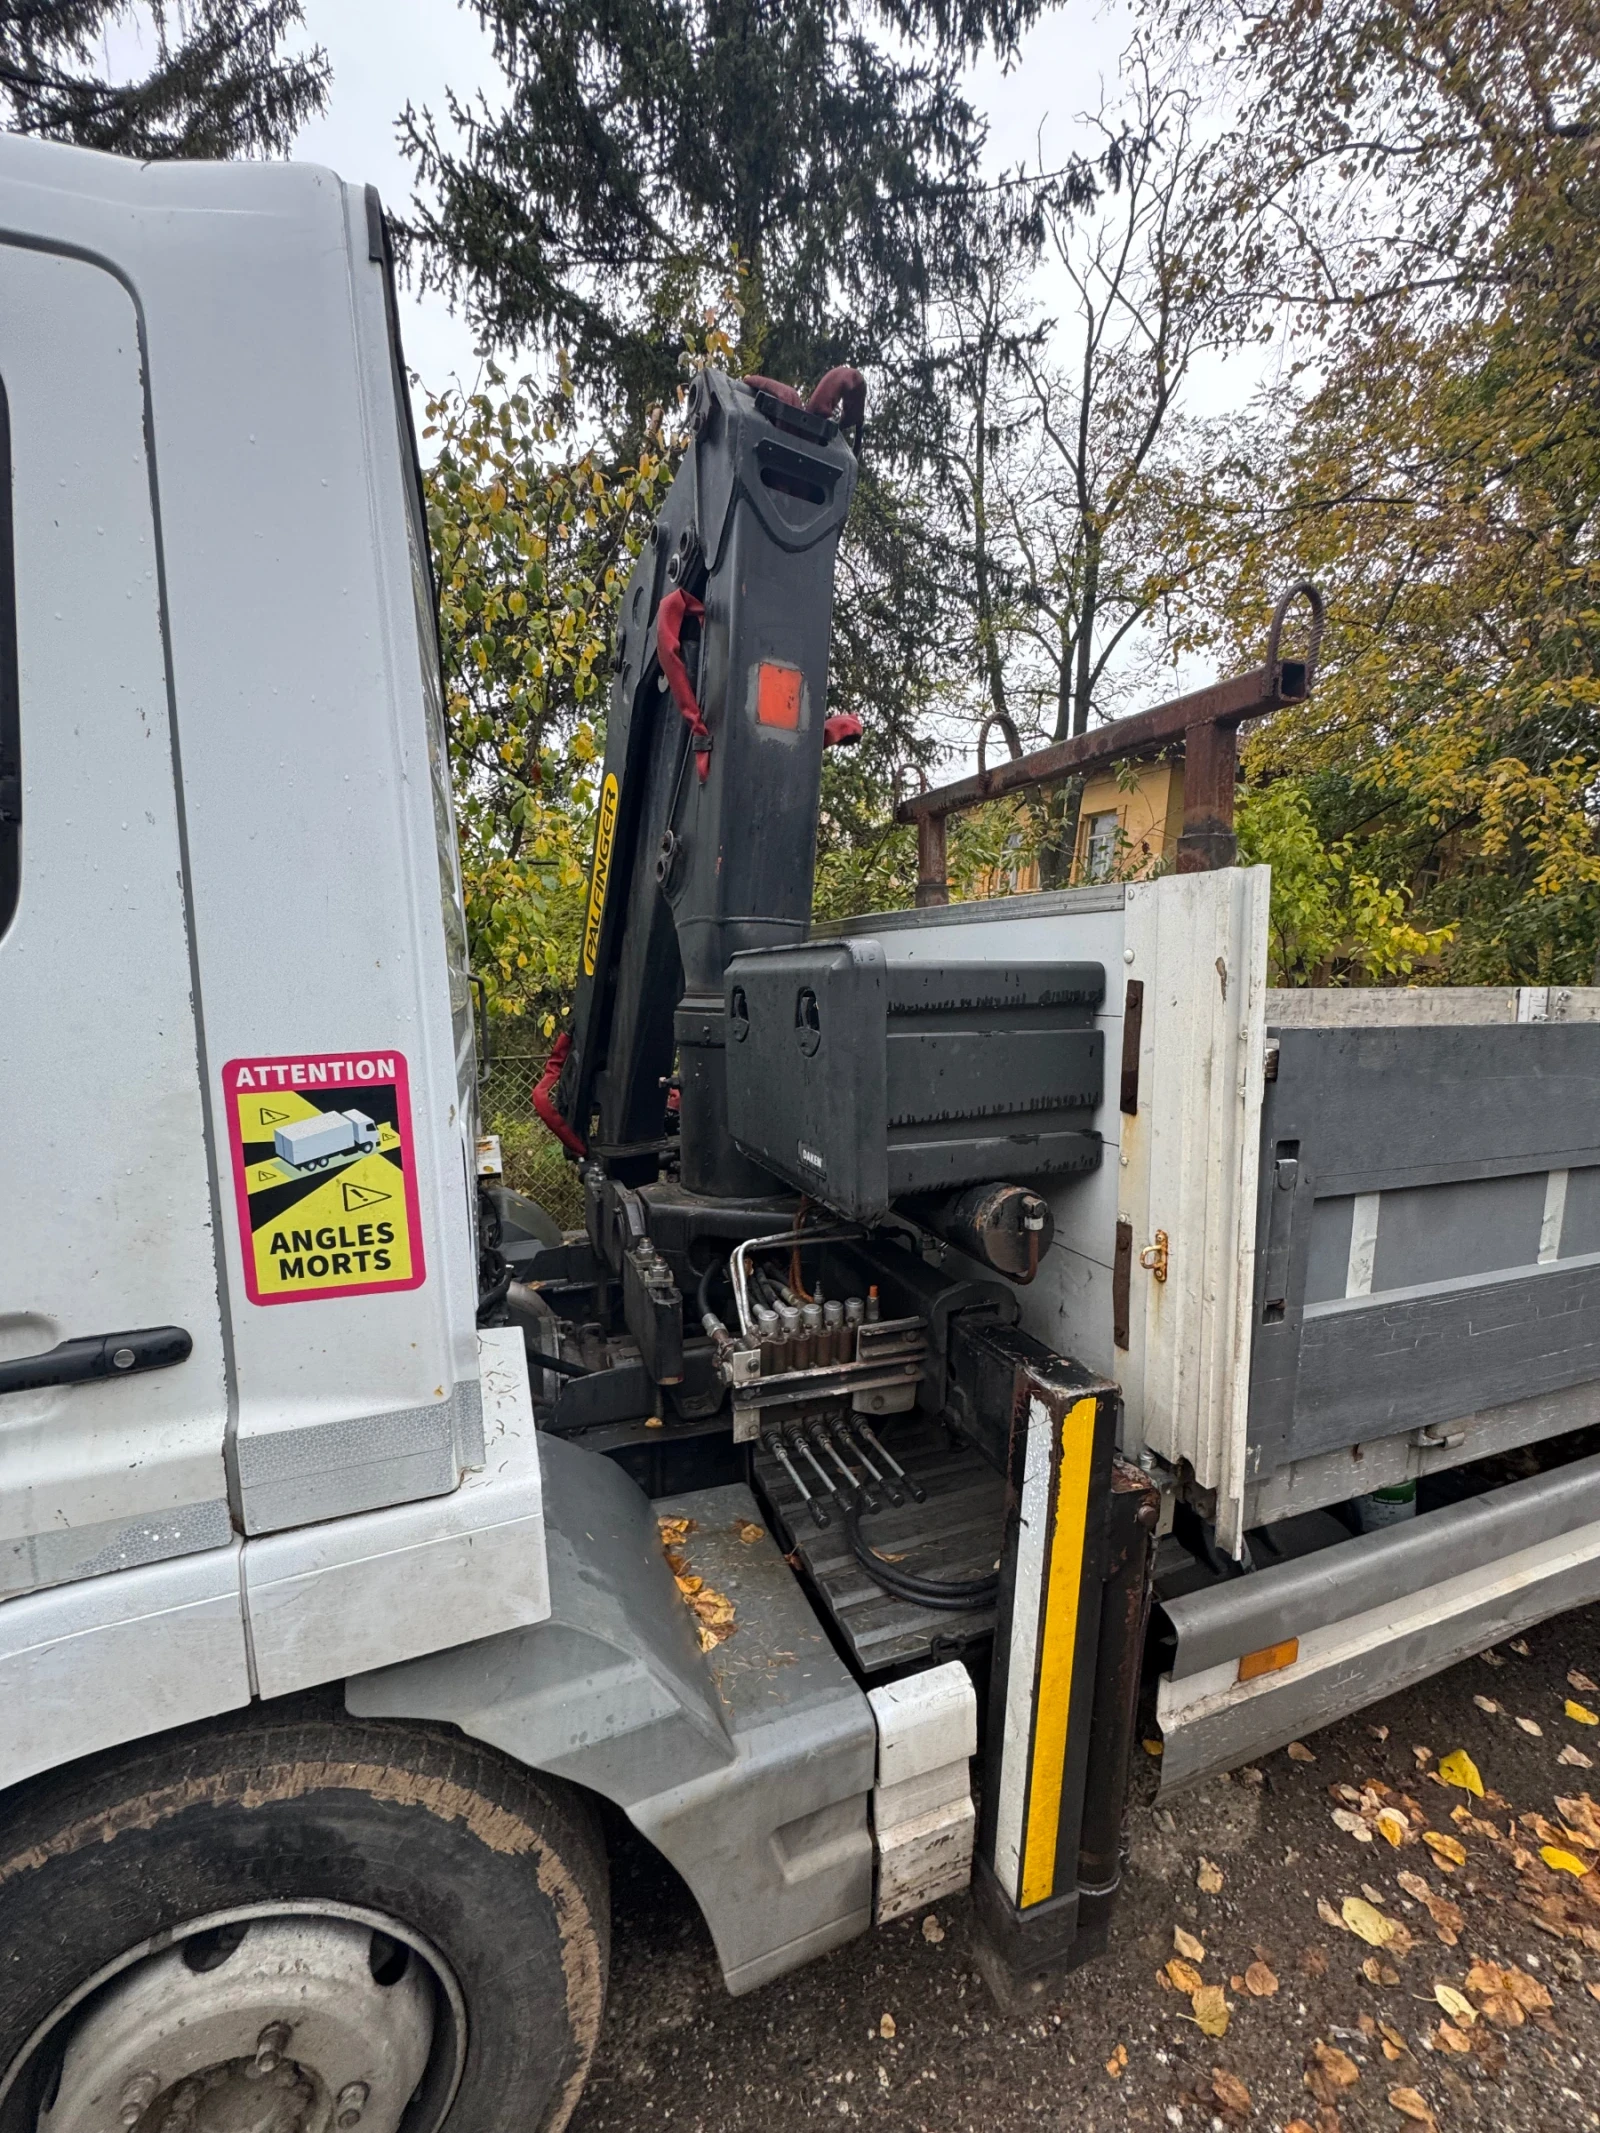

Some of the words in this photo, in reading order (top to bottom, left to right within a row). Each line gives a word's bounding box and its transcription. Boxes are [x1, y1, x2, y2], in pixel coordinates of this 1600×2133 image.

[586, 787, 616, 969] PALFINGER
[236, 1059, 396, 1087] ATTENTION
[802, 1149, 822, 1168] DAKEN
[269, 1222, 395, 1255] ANGLES
[279, 1248, 392, 1280] MORTS
